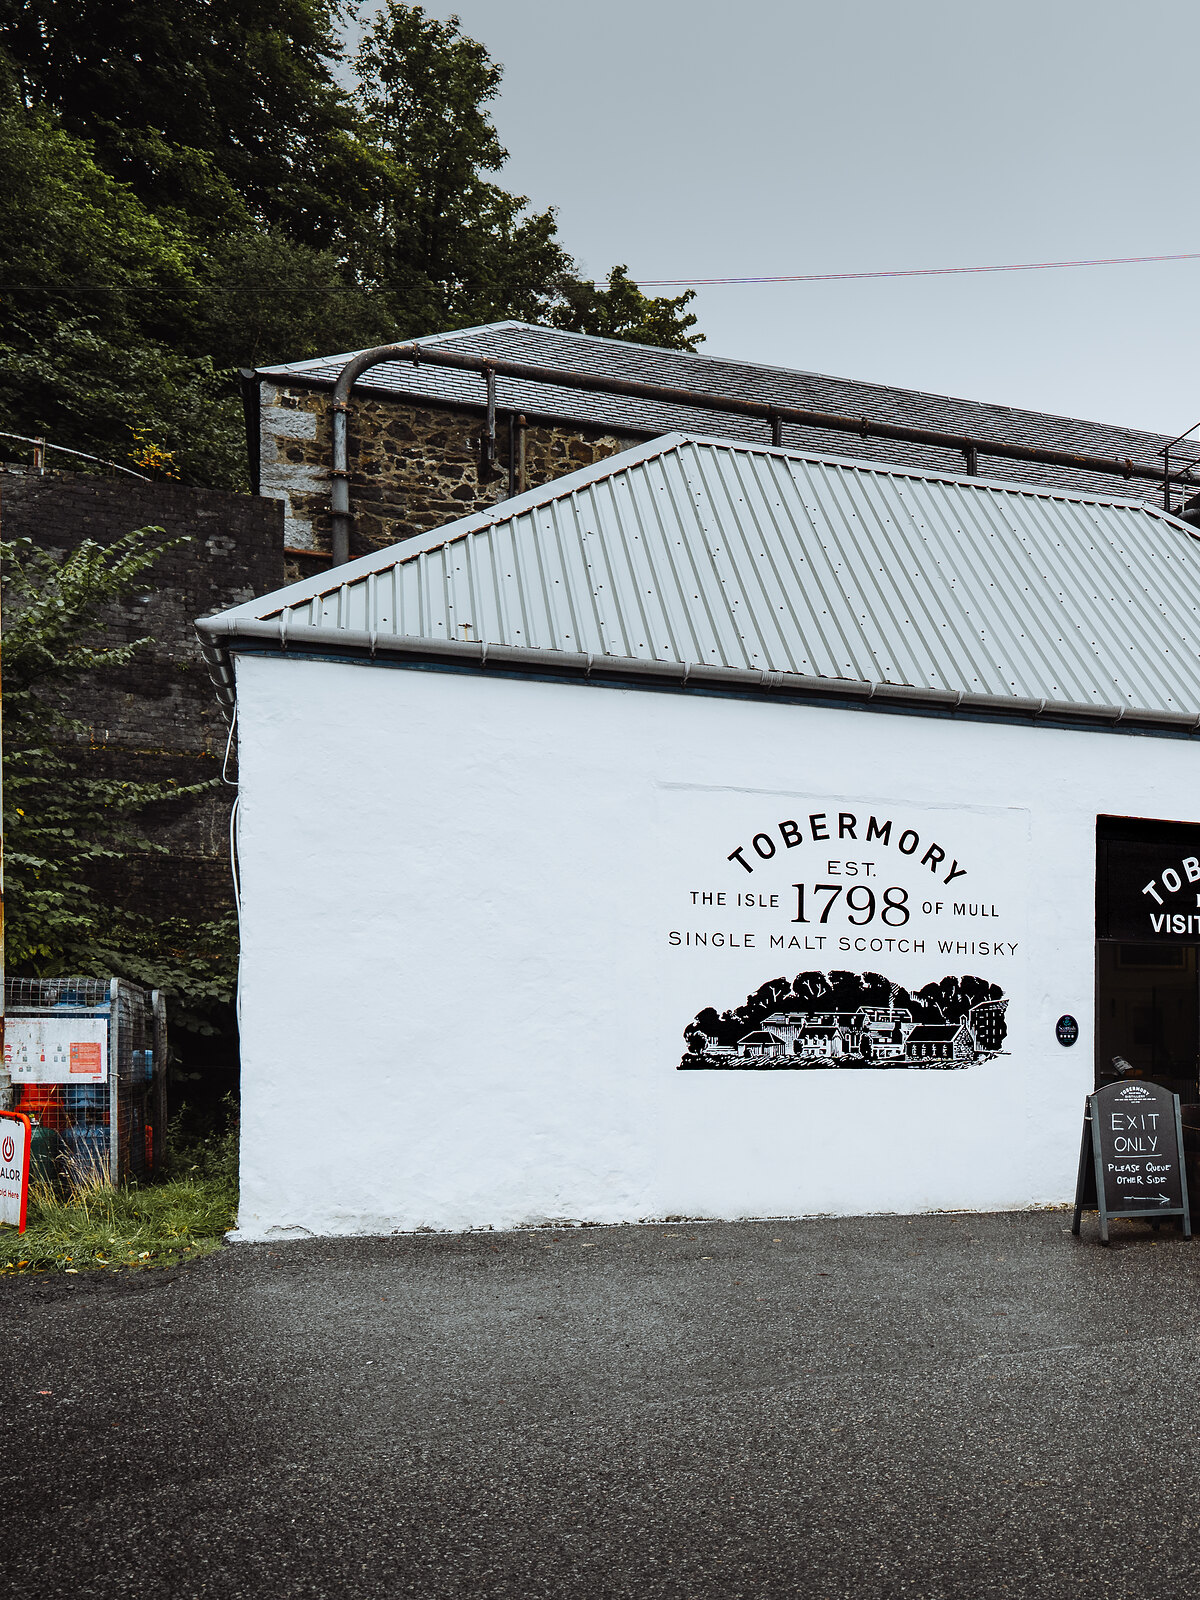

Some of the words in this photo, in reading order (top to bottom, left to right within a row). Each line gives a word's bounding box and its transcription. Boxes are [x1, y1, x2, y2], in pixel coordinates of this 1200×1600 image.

[727, 812, 968, 886] TOBERMORY
[827, 860, 877, 877] EST.
[690, 891, 726, 906] THE
[737, 893, 779, 908] ISLE
[790, 883, 911, 927] 1798
[921, 901, 944, 915] OF
[953, 902, 1000, 917] MULL
[668, 931, 756, 949] SINGLE
[769, 935, 827, 950] MALT
[838, 937, 925, 953] SCOTCH
[937, 940, 1019, 956] WHISKY
[1111, 1113, 1160, 1131] EXIT
[1114, 1136, 1158, 1152] ONLY
[0, 1167, 20, 1181] ALOR
[1108, 1163, 1140, 1172] PLEASE
[1145, 1162, 1172, 1172] QUEUE
[1116, 1175, 1144, 1185] OTHER
[1146, 1174, 1167, 1184] SIDE
[8, 1190, 19, 1199] Here
